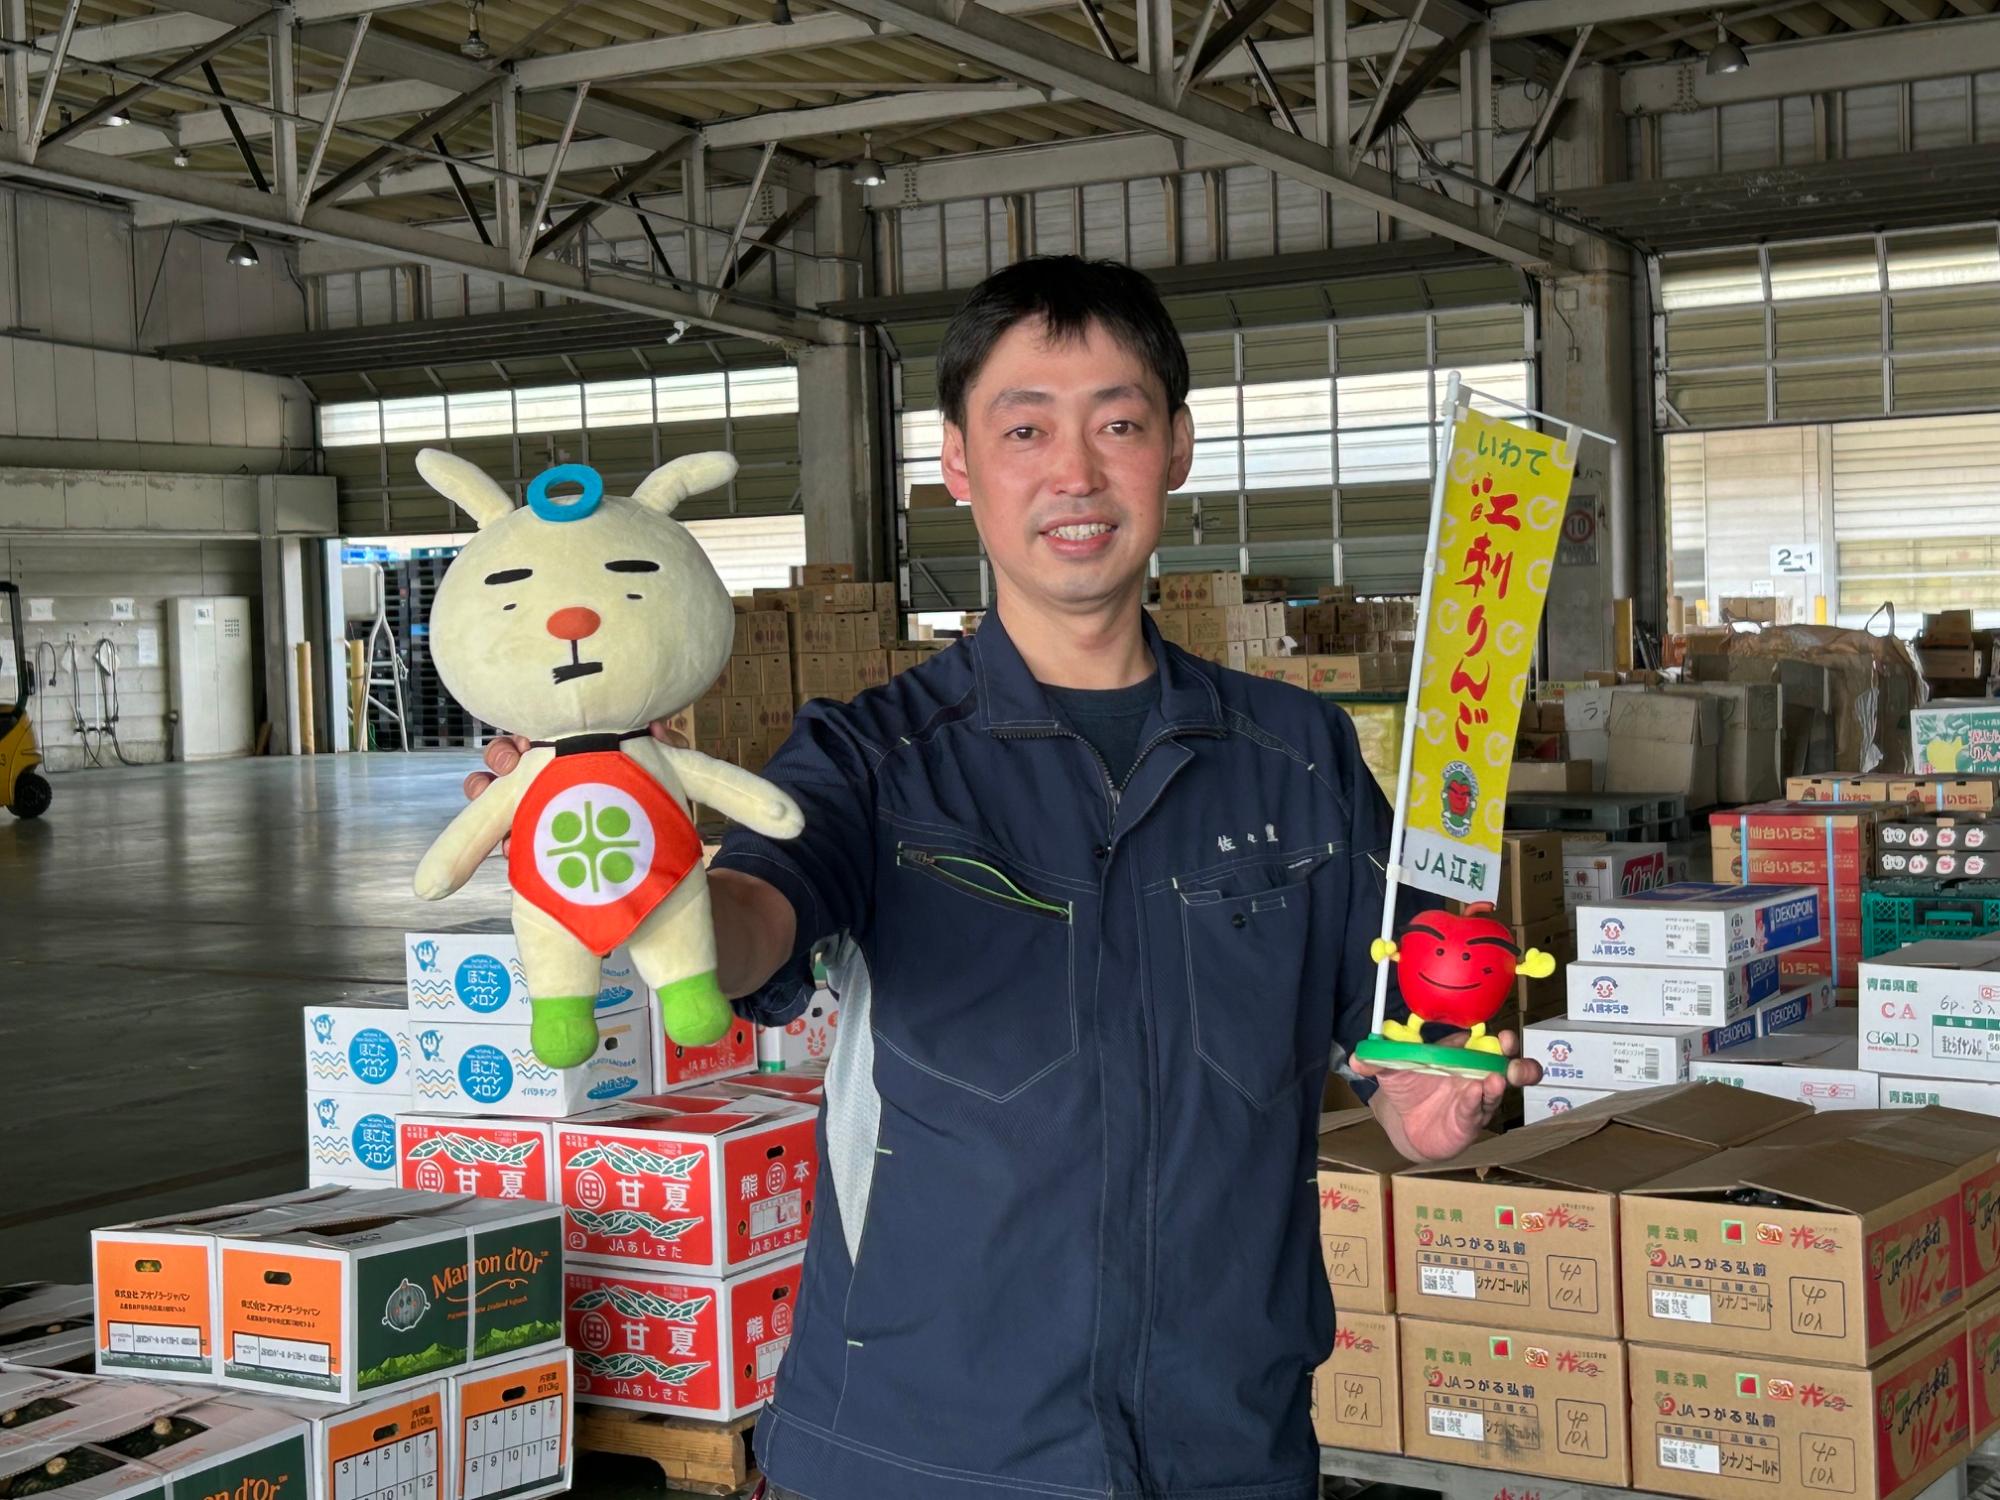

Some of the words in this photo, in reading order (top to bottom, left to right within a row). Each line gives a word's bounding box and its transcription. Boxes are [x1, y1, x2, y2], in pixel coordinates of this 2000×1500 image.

[1477, 431, 1547, 476] いわて
[1571, 518, 1587, 536] 10
[1777, 548, 1813, 566] 2-1
[1450, 472, 1521, 752] 江刺りんご
[1414, 848, 1486, 891] JA江刺
[1775, 899, 1814, 922] DEKOPON
[467, 970, 498, 984] ほこた
[1867, 977, 1918, 993] 青森県産
[469, 994, 498, 1006] メロン
[1770, 1003, 1803, 1027] DEKOPON
[1717, 1019, 1752, 1046] DEKOPON
[1866, 1030, 1919, 1048] GOLD
[359, 1044, 387, 1057] ほこた
[361, 1065, 387, 1077] メロン
[470, 1059, 500, 1075] ほこた
[472, 1084, 501, 1097] メロン
[363, 1128, 391, 1143] ほこた
[364, 1151, 392, 1164] メロン
[453, 1167, 526, 1198] 甘夏
[740, 1174, 758, 1200] 熊
[793, 1160, 810, 1183] 本
[615, 1178, 691, 1212] 甘夏
[1416, 1206, 1463, 1222] 青森県
[747, 1228, 802, 1257] JAあしきた
[1436, 1234, 1526, 1255] JAつがる弘前
[1647, 1225, 1698, 1243] 青森県
[608, 1239, 682, 1258] JAあしきた
[431, 1254, 500, 1299] Marron
[505, 1246, 543, 1274] d'Or
[1668, 1255, 1767, 1277] JAつがる弘前
[1477, 1276, 1528, 1295] シナノゴールド
[620, 1321, 697, 1356] 甘夏
[746, 1315, 764, 1343] 熊
[1425, 1347, 1472, 1367] 青森県
[1444, 1375, 1535, 1399] JAつがる弘前
[1656, 1369, 1708, 1389] 青森県
[613, 1380, 689, 1403] JAあしきた
[472, 1420, 479, 1431] 3
[492, 1415, 498, 1425] 4
[511, 1410, 518, 1421] 5
[530, 1405, 537, 1415] 6
[549, 1400, 555, 1411] 7
[1677, 1404, 1776, 1428] JAつがる弘前
[342, 1463, 349, 1474] 3
[362, 1455, 370, 1466] 4
[383, 1449, 391, 1460] 5
[404, 1442, 411, 1453] 6
[424, 1435, 430, 1446] 7
[471, 1461, 478, 1472] 8
[490, 1456, 497, 1467] 9
[508, 1450, 519, 1462] 10
[527, 1444, 537, 1456] 11
[546, 1440, 557, 1451] 12
[1721, 1451, 1779, 1476] シナノゴールド
[402, 1483, 413, 1496] 11
[422, 1475, 433, 1488] 12
